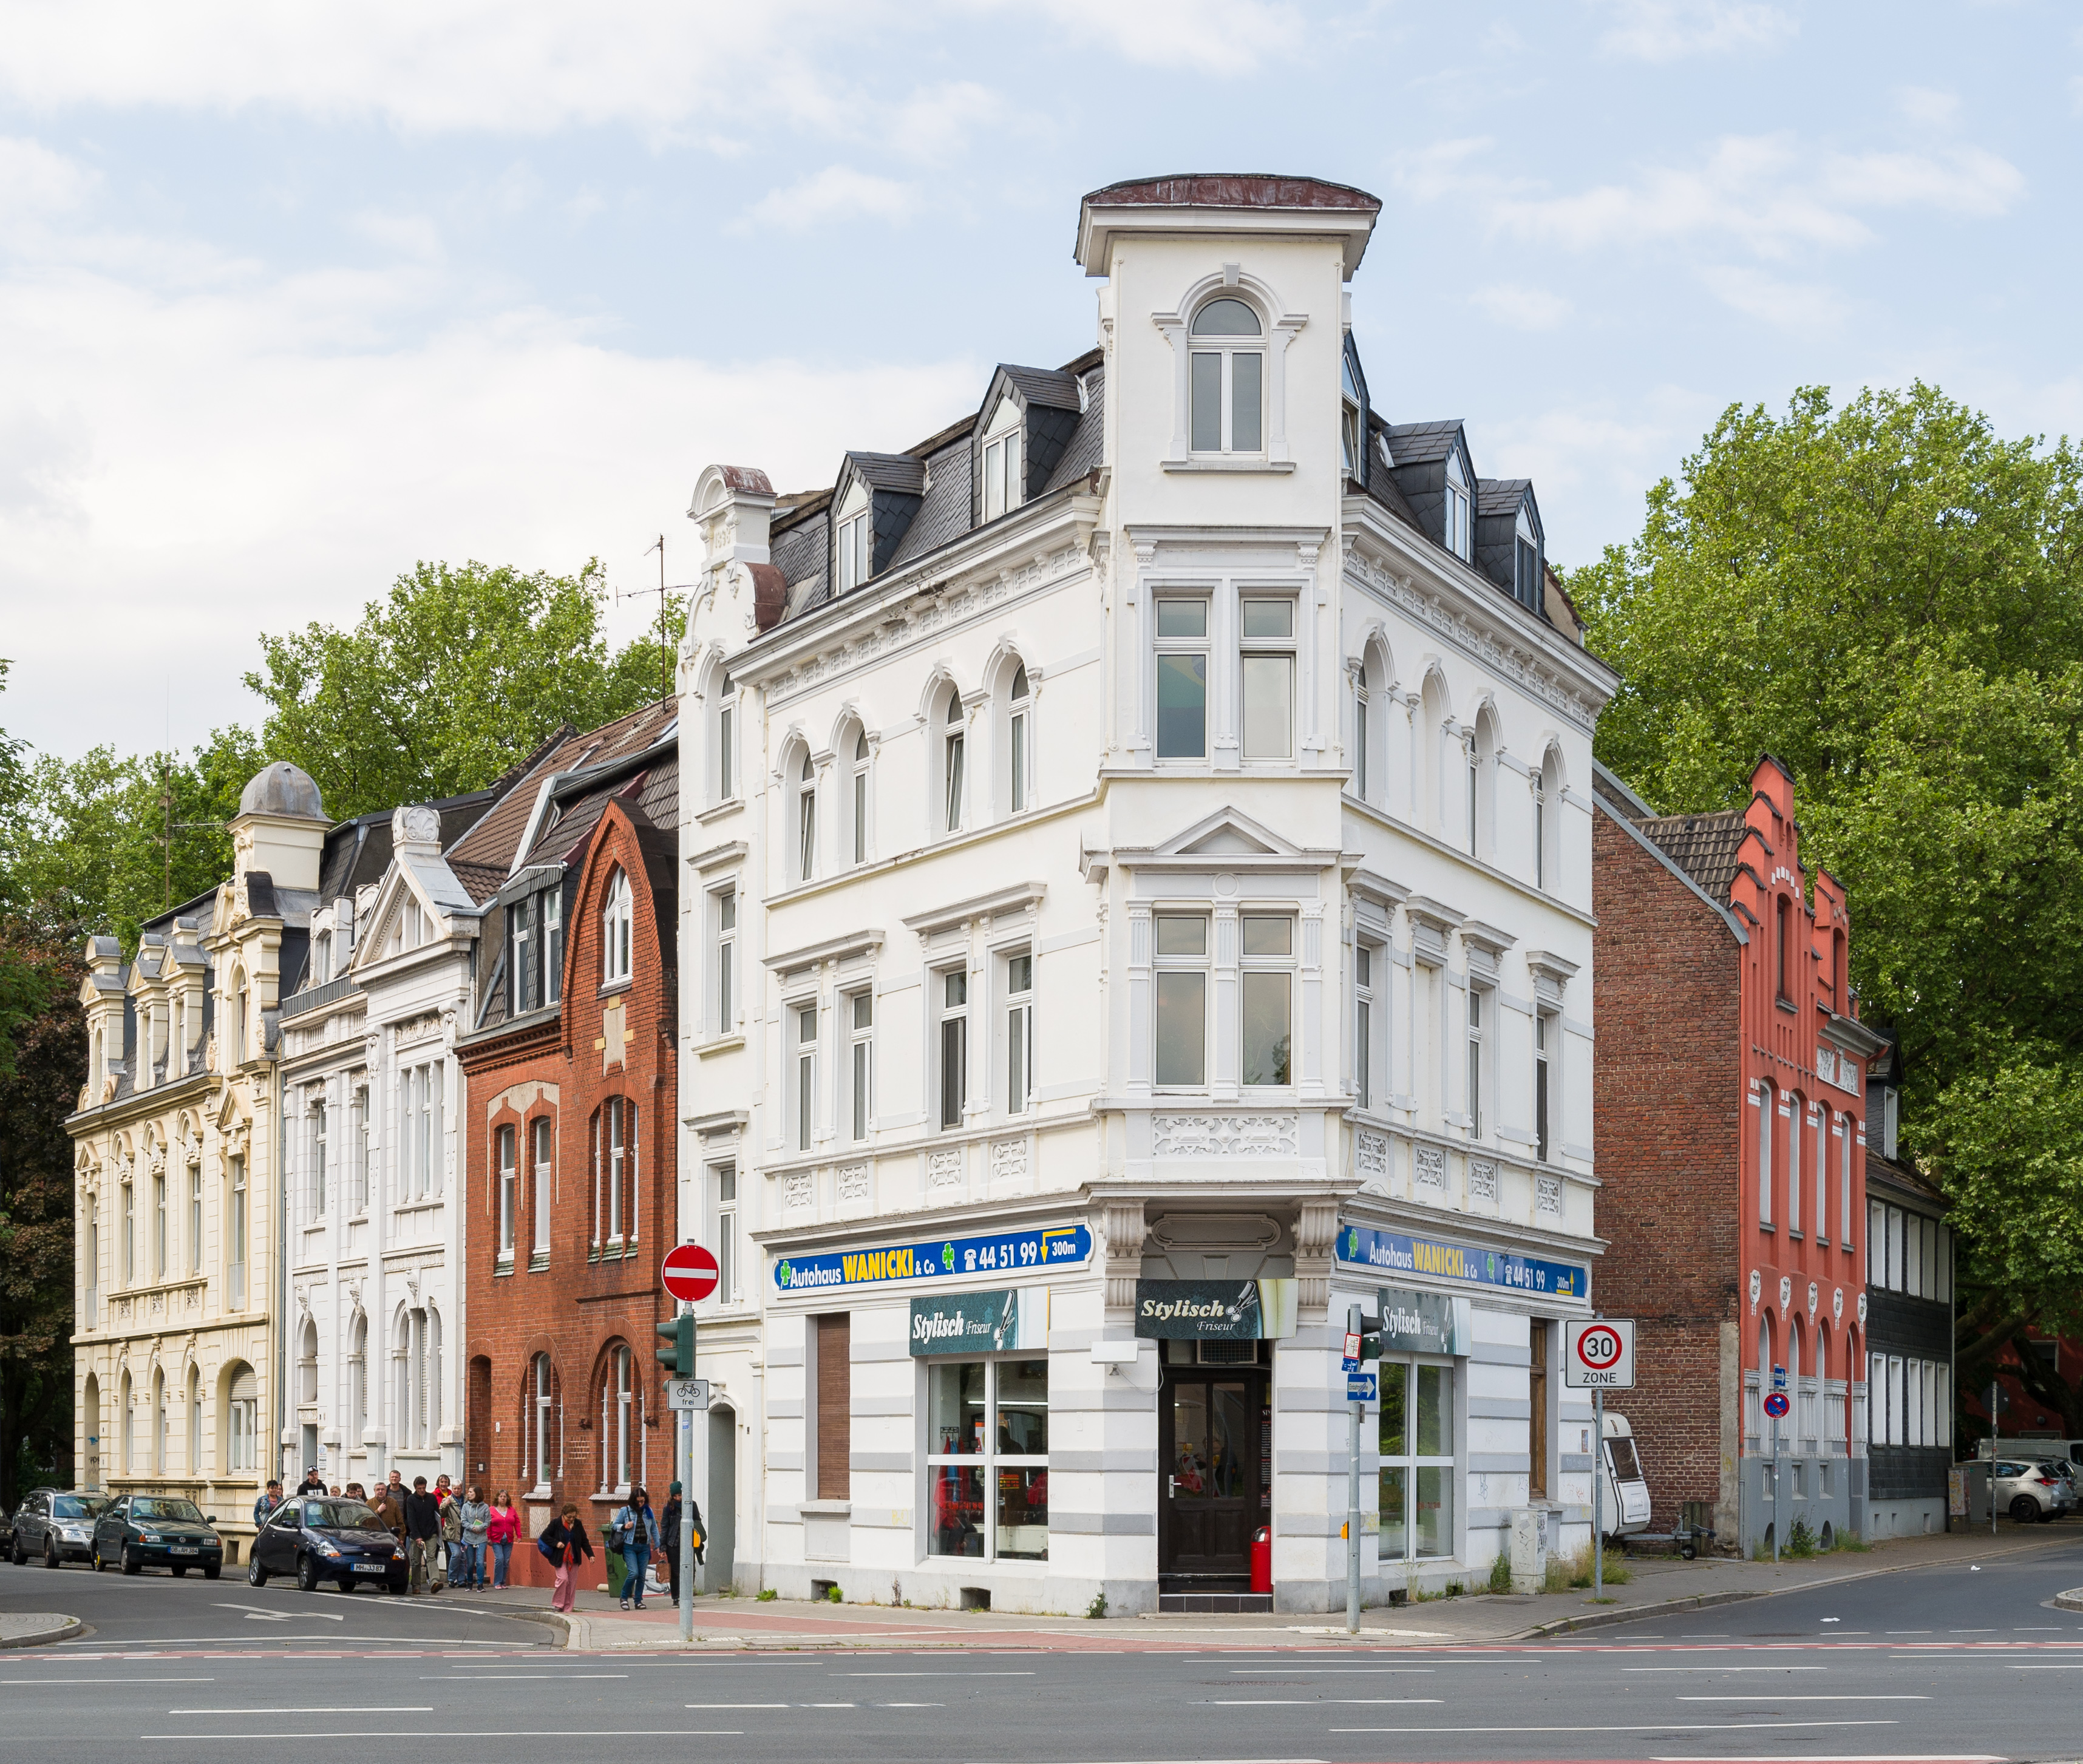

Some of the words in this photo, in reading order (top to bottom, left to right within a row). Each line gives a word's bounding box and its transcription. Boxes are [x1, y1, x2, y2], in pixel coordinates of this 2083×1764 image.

[979, 1247, 996, 1269] 44
[999, 1244, 1016, 1266] 51
[1021, 1242, 1038, 1264] 99
[1052, 1240, 1076, 1257] 300m
[1370, 1241, 1412, 1269] Autohaus
[1413, 1242, 1464, 1277] WANICKI
[1464, 1263, 1469, 1278] &
[1470, 1268, 1478, 1279] Co
[790, 1264, 841, 1287] Autohaus
[843, 1249, 914, 1282] WANICKI
[915, 1260, 922, 1275] &
[924, 1259, 935, 1274] Co
[1514, 1266, 1523, 1285] 44
[1525, 1268, 1534, 1287] 51
[1536, 1270, 1545, 1290] 99
[1557, 1276, 1569, 1290] 300m
[1141, 1299, 1225, 1321] Stylisch
[1382, 1304, 1421, 1339] Stylisch
[1423, 1321, 1438, 1336] Friseur
[912, 1310, 964, 1345] Stylisch
[966, 1318, 992, 1335] Friseur
[1196, 1321, 1235, 1331] Friseur
[1587, 1337, 1612, 1357] 30
[1583, 1372, 1616, 1383] ZONE
